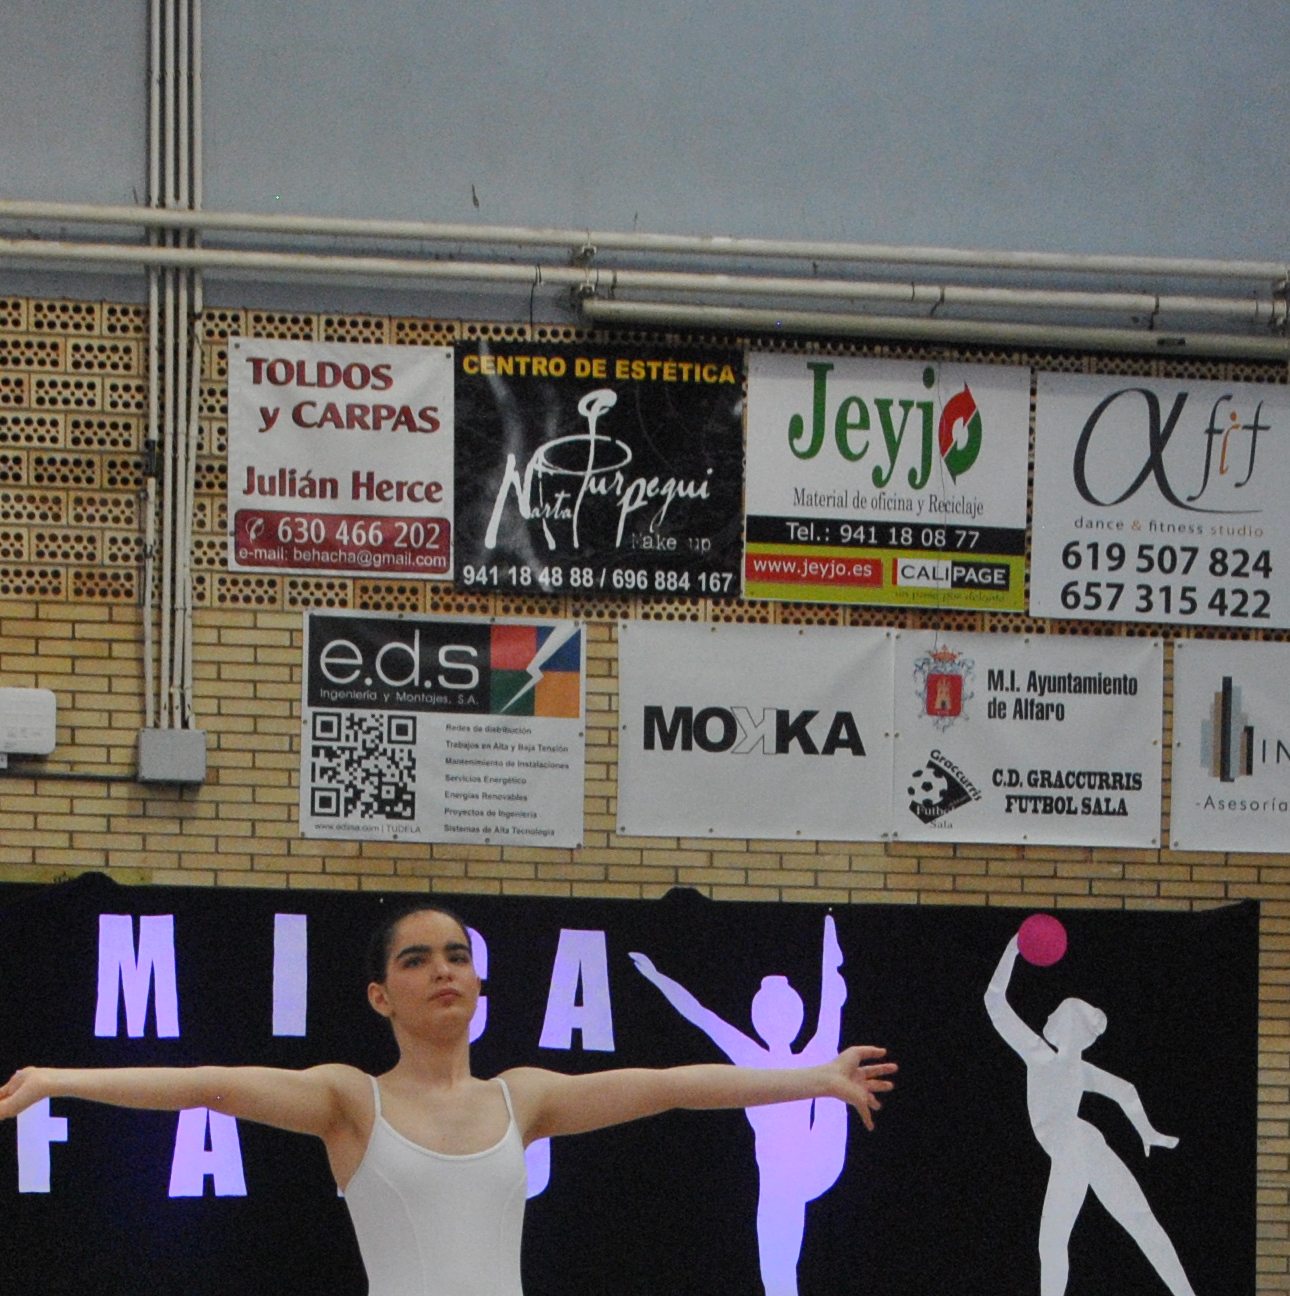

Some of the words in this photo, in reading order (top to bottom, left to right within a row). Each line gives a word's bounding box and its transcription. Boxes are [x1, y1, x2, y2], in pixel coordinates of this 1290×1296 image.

[246, 357, 393, 390] TOLDOS
[463, 355, 566, 377] CENTRO
[575, 358, 606, 378] DE
[616, 358, 735, 384] ESTÉTICA
[259, 407, 280, 432] y
[292, 401, 440, 433] CARPAS
[788, 362, 983, 490] Jeyjo
[243, 466, 338, 499] Julián
[352, 471, 443, 503] Herce
[793, 487, 848, 509] Material
[852, 490, 867, 510] de
[870, 491, 913, 512] oficina
[917, 498, 924, 517] y
[928, 494, 984, 519] Reciclaje
[278, 517, 325, 544] 630
[336, 519, 382, 546] 466
[394, 521, 440, 549] 202
[786, 522, 830, 542] Tel.:
[840, 524, 878, 544] 941
[889, 526, 912, 545] 18
[921, 527, 946, 547] 08
[955, 530, 979, 549] 77
[1075, 516, 1124, 531] dance
[1131, 520, 1141, 531] &
[1149, 520, 1203, 535] fitness
[1210, 523, 1263, 538] studio
[632, 533, 677, 551] Make
[688, 538, 711, 555] up
[239, 549, 287, 563] e-mail:
[294, 549, 446, 568] behacha@gmail.com
[753, 558, 872, 579] www.jeyjo.es
[901, 564, 1006, 584] CALIPAGE
[1062, 541, 1125, 571] 619
[1136, 544, 1199, 575] 507
[1209, 547, 1272, 579] 824
[463, 566, 498, 586] 941
[509, 566, 531, 586] 18
[538, 567, 562, 587] 48
[570, 567, 593, 588] 88
[613, 569, 648, 589] 696
[655, 570, 690, 591] 884
[699, 572, 733, 593] 167
[1061, 581, 1124, 611] 657
[1135, 584, 1197, 615] 315
[1208, 587, 1271, 619] 422
[320, 629, 479, 690] e.d.s
[988, 669, 1021, 692] M.I.
[1027, 670, 1138, 696] Ayuntamiento
[320, 689, 377, 701] Ingeniería
[383, 692, 390, 703] y
[988, 697, 1007, 719] de
[1013, 698, 1065, 721] Alfaro
[446, 724, 470, 732] Redes
[485, 725, 532, 734] distribución
[644, 706, 866, 757] MOKKA
[446, 740, 479, 751] Trabajos
[493, 742, 508, 750] Alta
[518, 743, 535, 752] Baja
[538, 744, 568, 752] Tensión
[446, 757, 503, 766] Mantenimiento
[517, 760, 569, 769] Instalaciones
[930, 749, 982, 801] Graccurris
[445, 774, 481, 782] Servicios
[992, 768, 1023, 787] C.D.
[1027, 769, 1142, 791] GRACCURRIS
[482, 792, 527, 801] Renovables
[1005, 794, 1078, 815] FUTBOL
[1081, 797, 1128, 816] SALA
[444, 808, 484, 817] Proyectos
[487, 809, 496, 817] de
[930, 820, 953, 828] Sala
[387, 825, 421, 834] TUDELA
[444, 825, 480, 833] Sistemas
[494, 826, 509, 834] Alta
